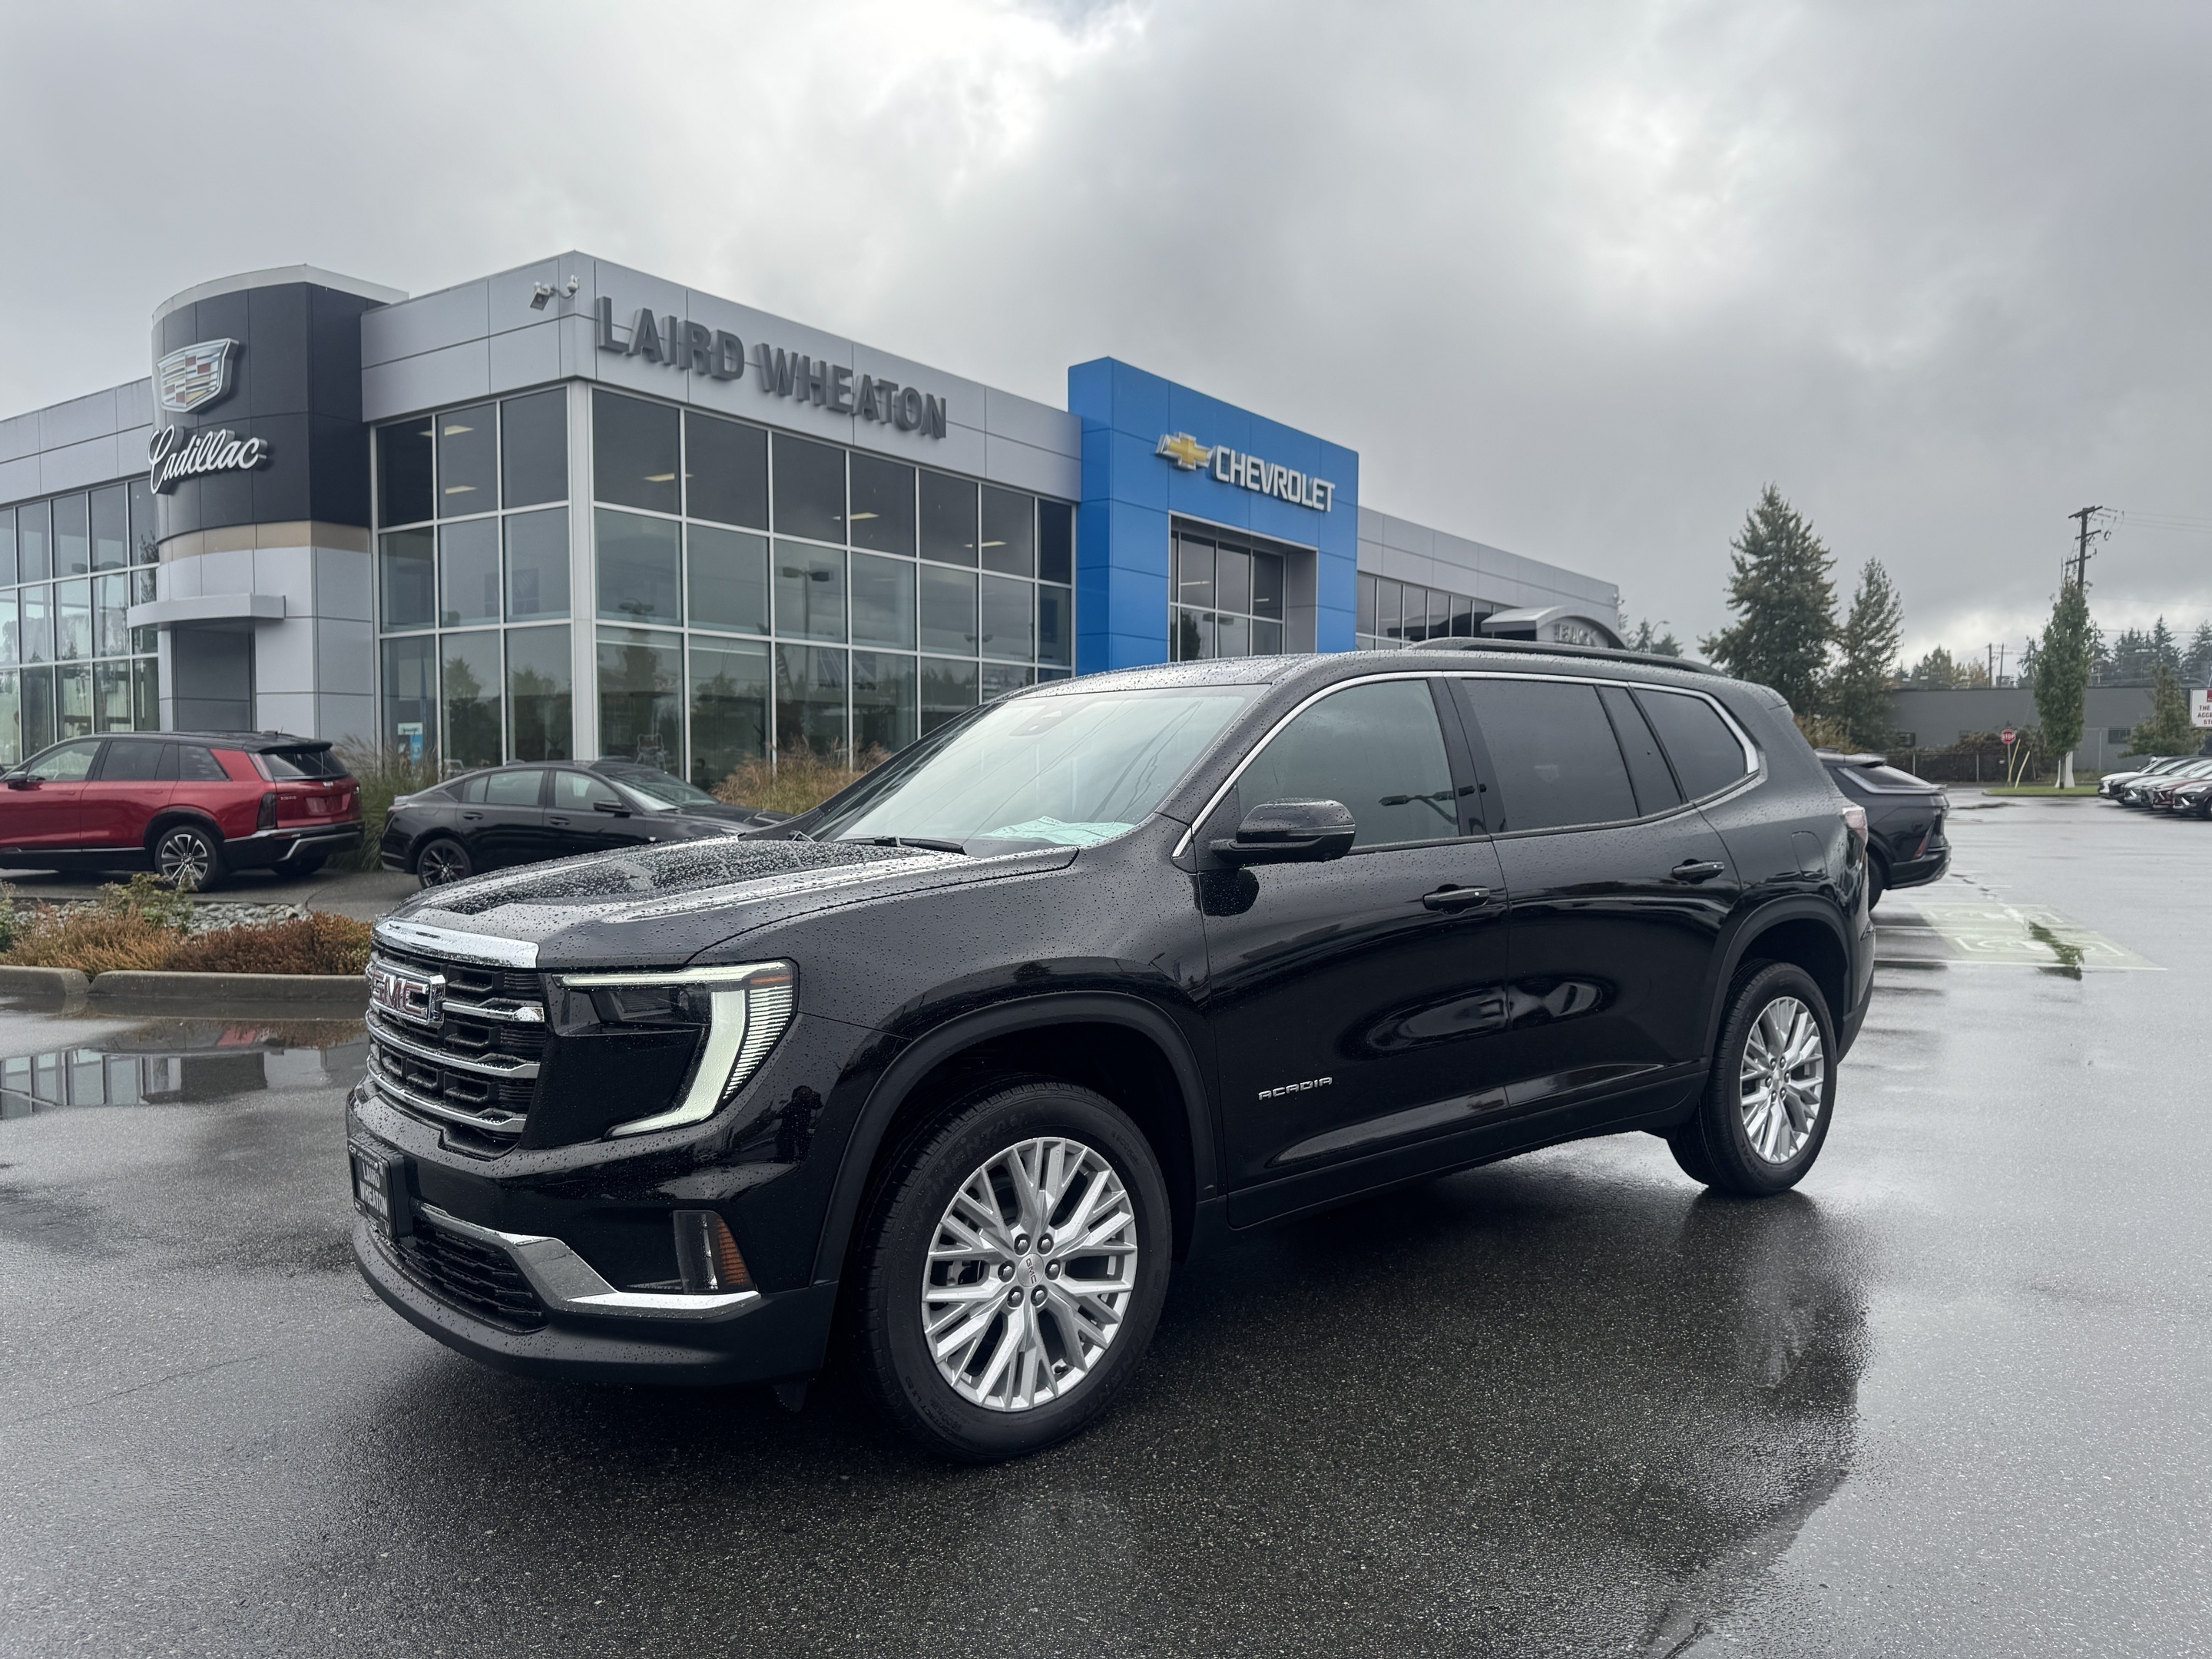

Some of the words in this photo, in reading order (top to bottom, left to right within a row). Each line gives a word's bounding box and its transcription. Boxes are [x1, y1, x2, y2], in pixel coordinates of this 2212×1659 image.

[598, 296, 745, 380] LAIRD
[756, 343, 946, 439] WHEATON
[147, 424, 260, 495] Cadillac
[1215, 445, 1336, 513] CHEVROLET
[373, 970, 428, 1018] GMC
[1258, 1077, 1333, 1100] ACADIA
[362, 1161, 380, 1188] LAIRD
[359, 1180, 387, 1217] WHEATON
[1026, 1258, 1037, 1284] GMC
